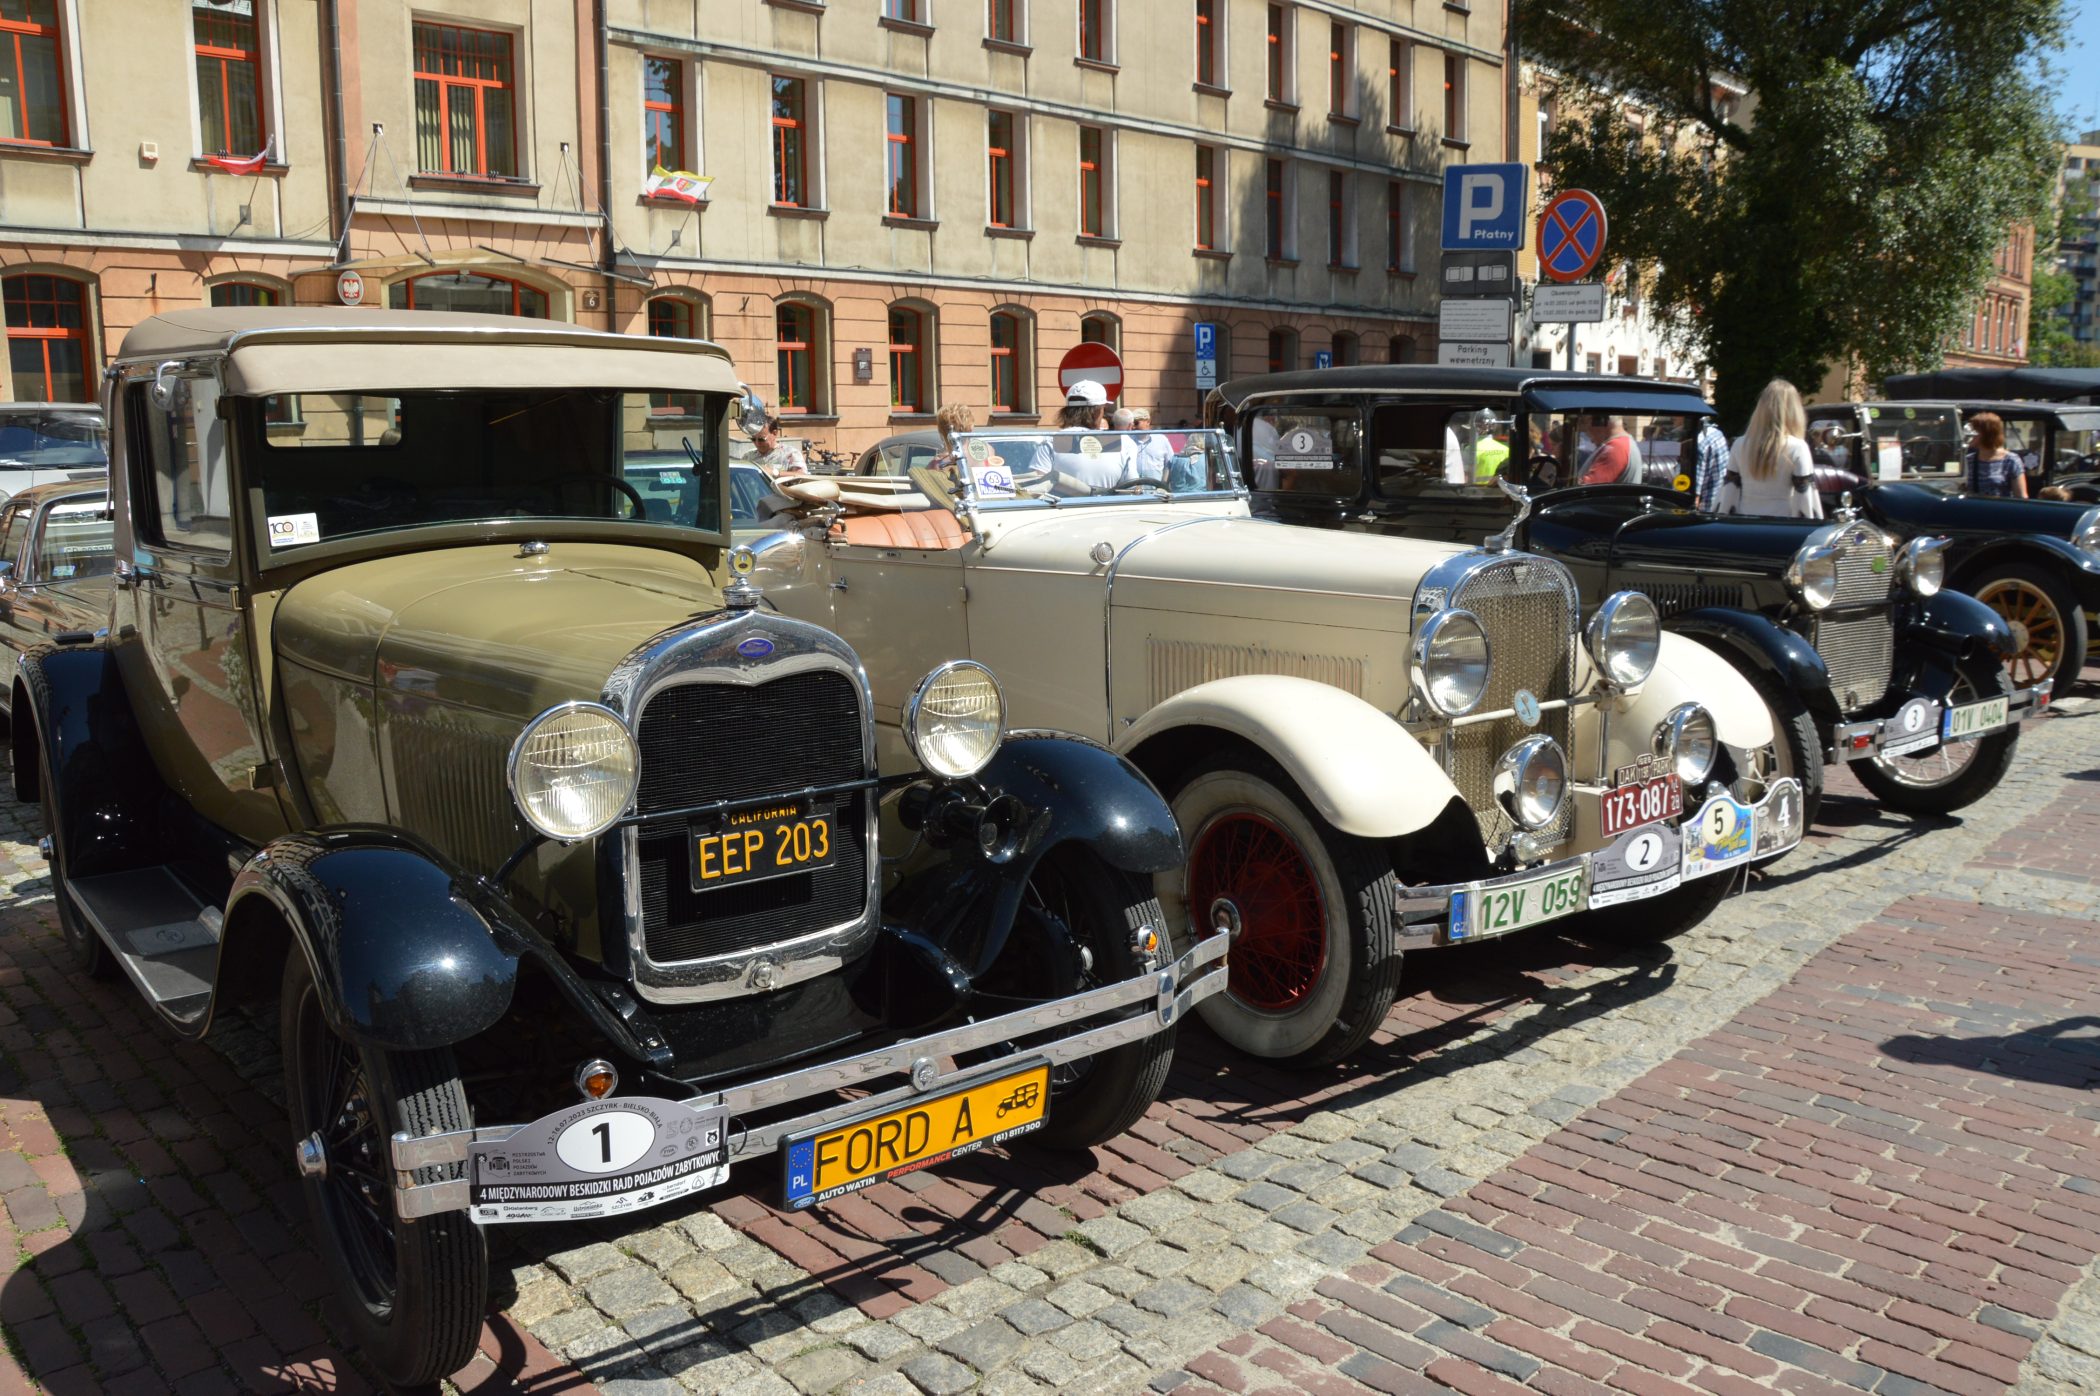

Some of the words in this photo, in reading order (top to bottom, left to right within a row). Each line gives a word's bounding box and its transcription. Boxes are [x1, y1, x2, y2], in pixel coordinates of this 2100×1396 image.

[1459, 174, 1504, 239] P
[1474, 229, 1514, 241] Płatny
[1200, 327, 1211, 349] P
[1458, 345, 1488, 356] Parking
[1450, 357, 1496, 367] wewnętrzny
[1300, 435, 1306, 449] 3
[1911, 709, 1918, 728] 3
[1620, 767, 1636, 784] OAK
[1653, 759, 1670, 777] PARK
[731, 805, 797, 825] CALIFORNIA
[1714, 807, 1723, 835] 5
[1778, 795, 1790, 828] 4
[700, 830, 764, 879] EEP
[776, 820, 828, 866] 203
[1640, 840, 1650, 865] 2
[1482, 888, 1526, 930] 12V
[1542, 875, 1582, 915] 059
[548, 1110, 585, 1145] 12-16.07.2023
[587, 1103, 618, 1114] SZCZYRK
[623, 1102, 663, 1129] BIELSKO-BIAŁA
[592, 1122, 611, 1163] 1
[814, 1110, 930, 1188] FORD
[952, 1096, 974, 1144] A
[993, 1132, 1008, 1144] (61)
[480, 1188, 487, 1200] 4
[488, 1184, 568, 1202] MIĘDZYNARODOWY
[569, 1180, 611, 1197] BESKIDZKI
[613, 1175, 632, 1192] RAJD
[634, 1165, 674, 1187] POJAZDÓW
[675, 1150, 720, 1175] ZABYTKOWYC
[792, 1175, 808, 1189] PL
[818, 1186, 845, 1202] AUTO
[846, 1176, 876, 1194] WATIN
